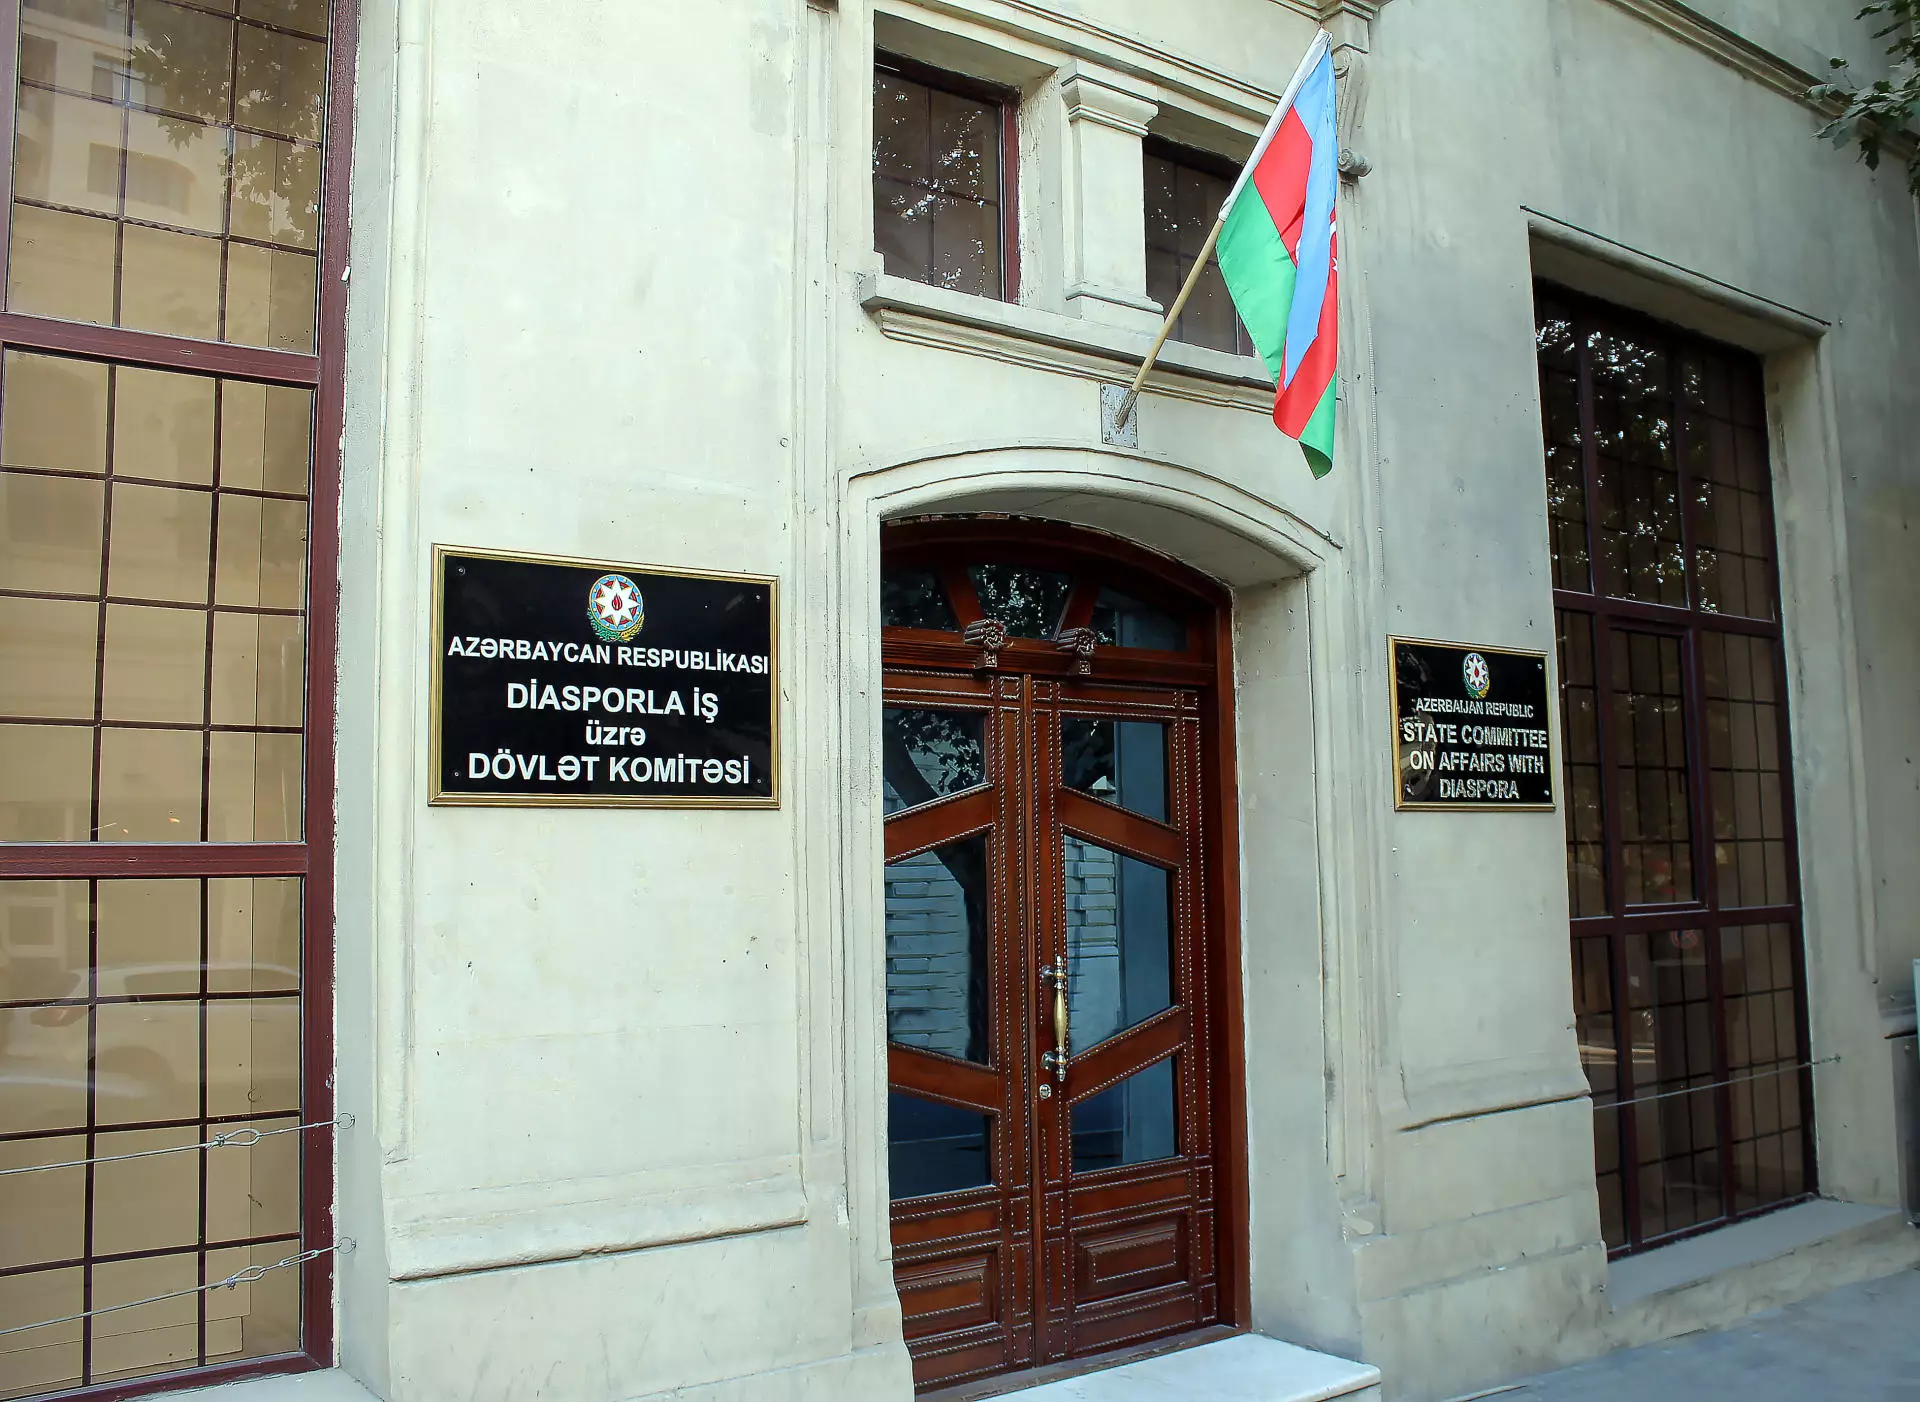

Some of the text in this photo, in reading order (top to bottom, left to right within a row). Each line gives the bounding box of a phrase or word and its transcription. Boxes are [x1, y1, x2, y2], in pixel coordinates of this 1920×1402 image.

[448, 636, 768, 674] AZƏRBAYCAN RESPUBLİKASI
[507, 678, 718, 722] DİASPORLA İŞ
[1415, 697, 1534, 718] AZERBAIJAN REPUBLIC
[586, 720, 646, 746] üzrə
[1403, 722, 1548, 748] STATE COMMITTEE
[469, 748, 749, 784] DÖVLƏT KOMİTƏSİ
[1410, 750, 1545, 774] ON AFFAIRS WITH
[1439, 778, 1520, 799] DIASPORA
